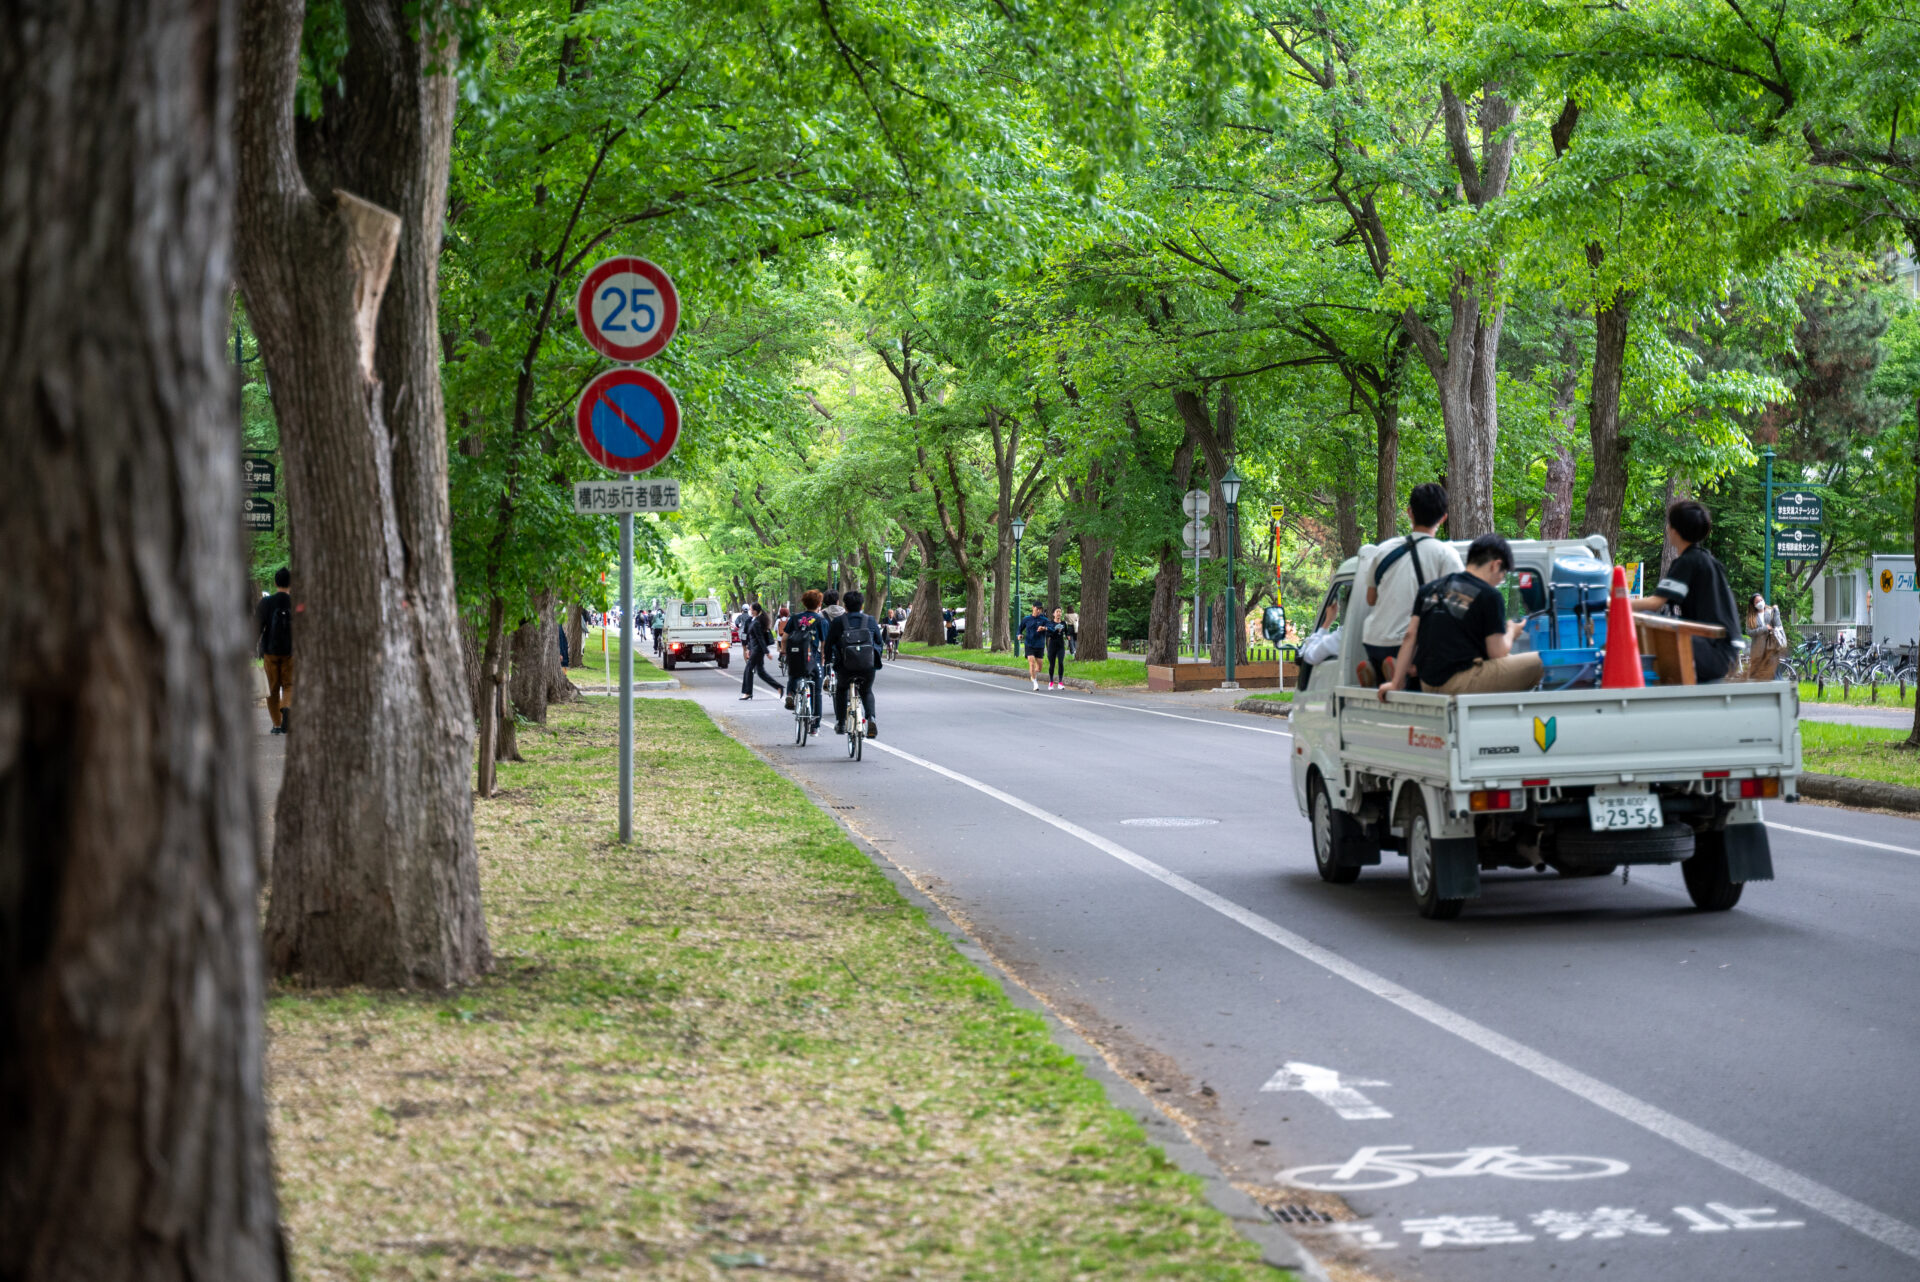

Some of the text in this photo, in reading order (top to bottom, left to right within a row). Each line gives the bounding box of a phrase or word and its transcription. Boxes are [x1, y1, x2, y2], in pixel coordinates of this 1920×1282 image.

[601, 287, 655, 333] 25
[578, 484, 677, 509] 構内歩行者優先
[1898, 575, 1913, 588] クール
[1606, 808, 1658, 826] 29-56
[1328, 1201, 1806, 1250] 走禁止
